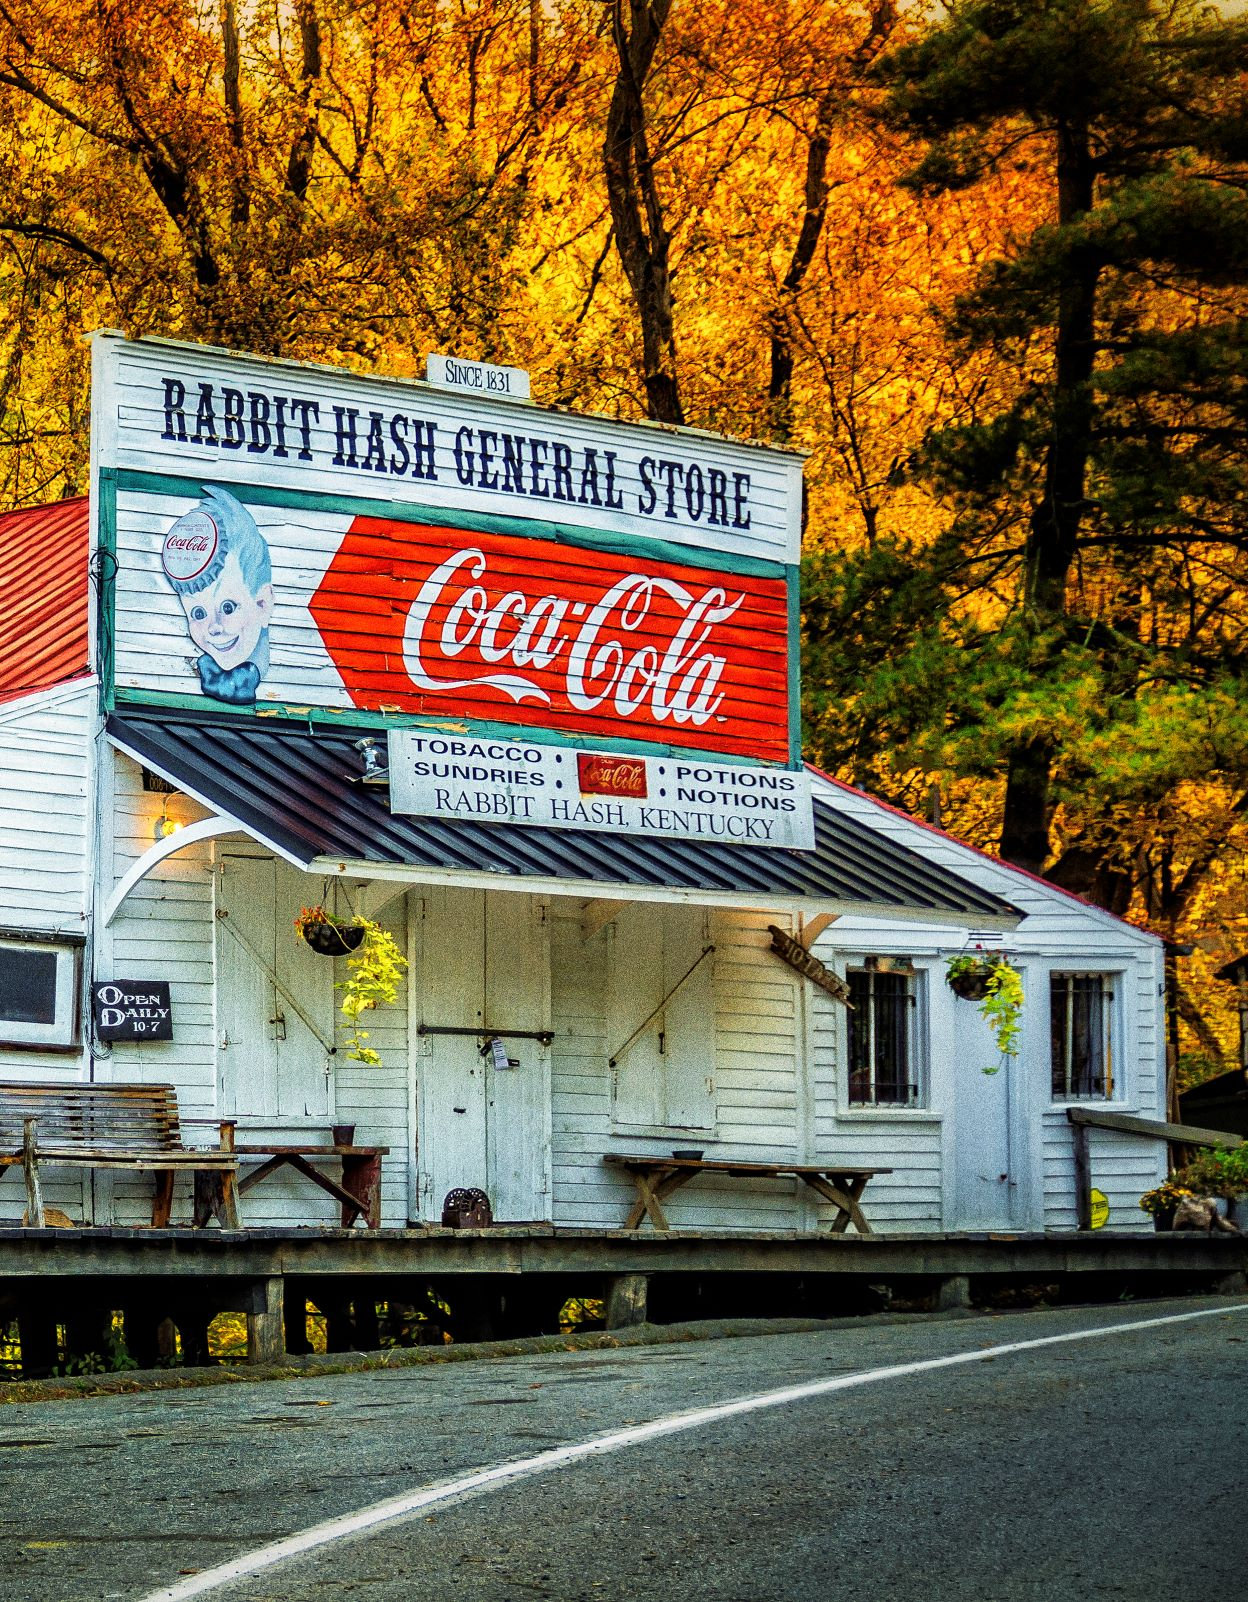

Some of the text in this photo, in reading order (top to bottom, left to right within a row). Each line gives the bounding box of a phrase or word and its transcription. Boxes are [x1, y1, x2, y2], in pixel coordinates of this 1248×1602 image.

[445, 359, 510, 392] SINCE 1831
[160, 377, 751, 530] RABBIT HASH GENERAL STORE
[402, 548, 746, 726] Coca-Cola
[411, 737, 542, 764] TOBACCO
[414, 761, 545, 787] SUNDRIES
[676, 766, 796, 791] POTIONS
[677, 787, 796, 812] NOTIONS
[434, 788, 775, 840] RABBIT HASH, KENTUCKY
[132, 1021, 161, 1032] 10-7
